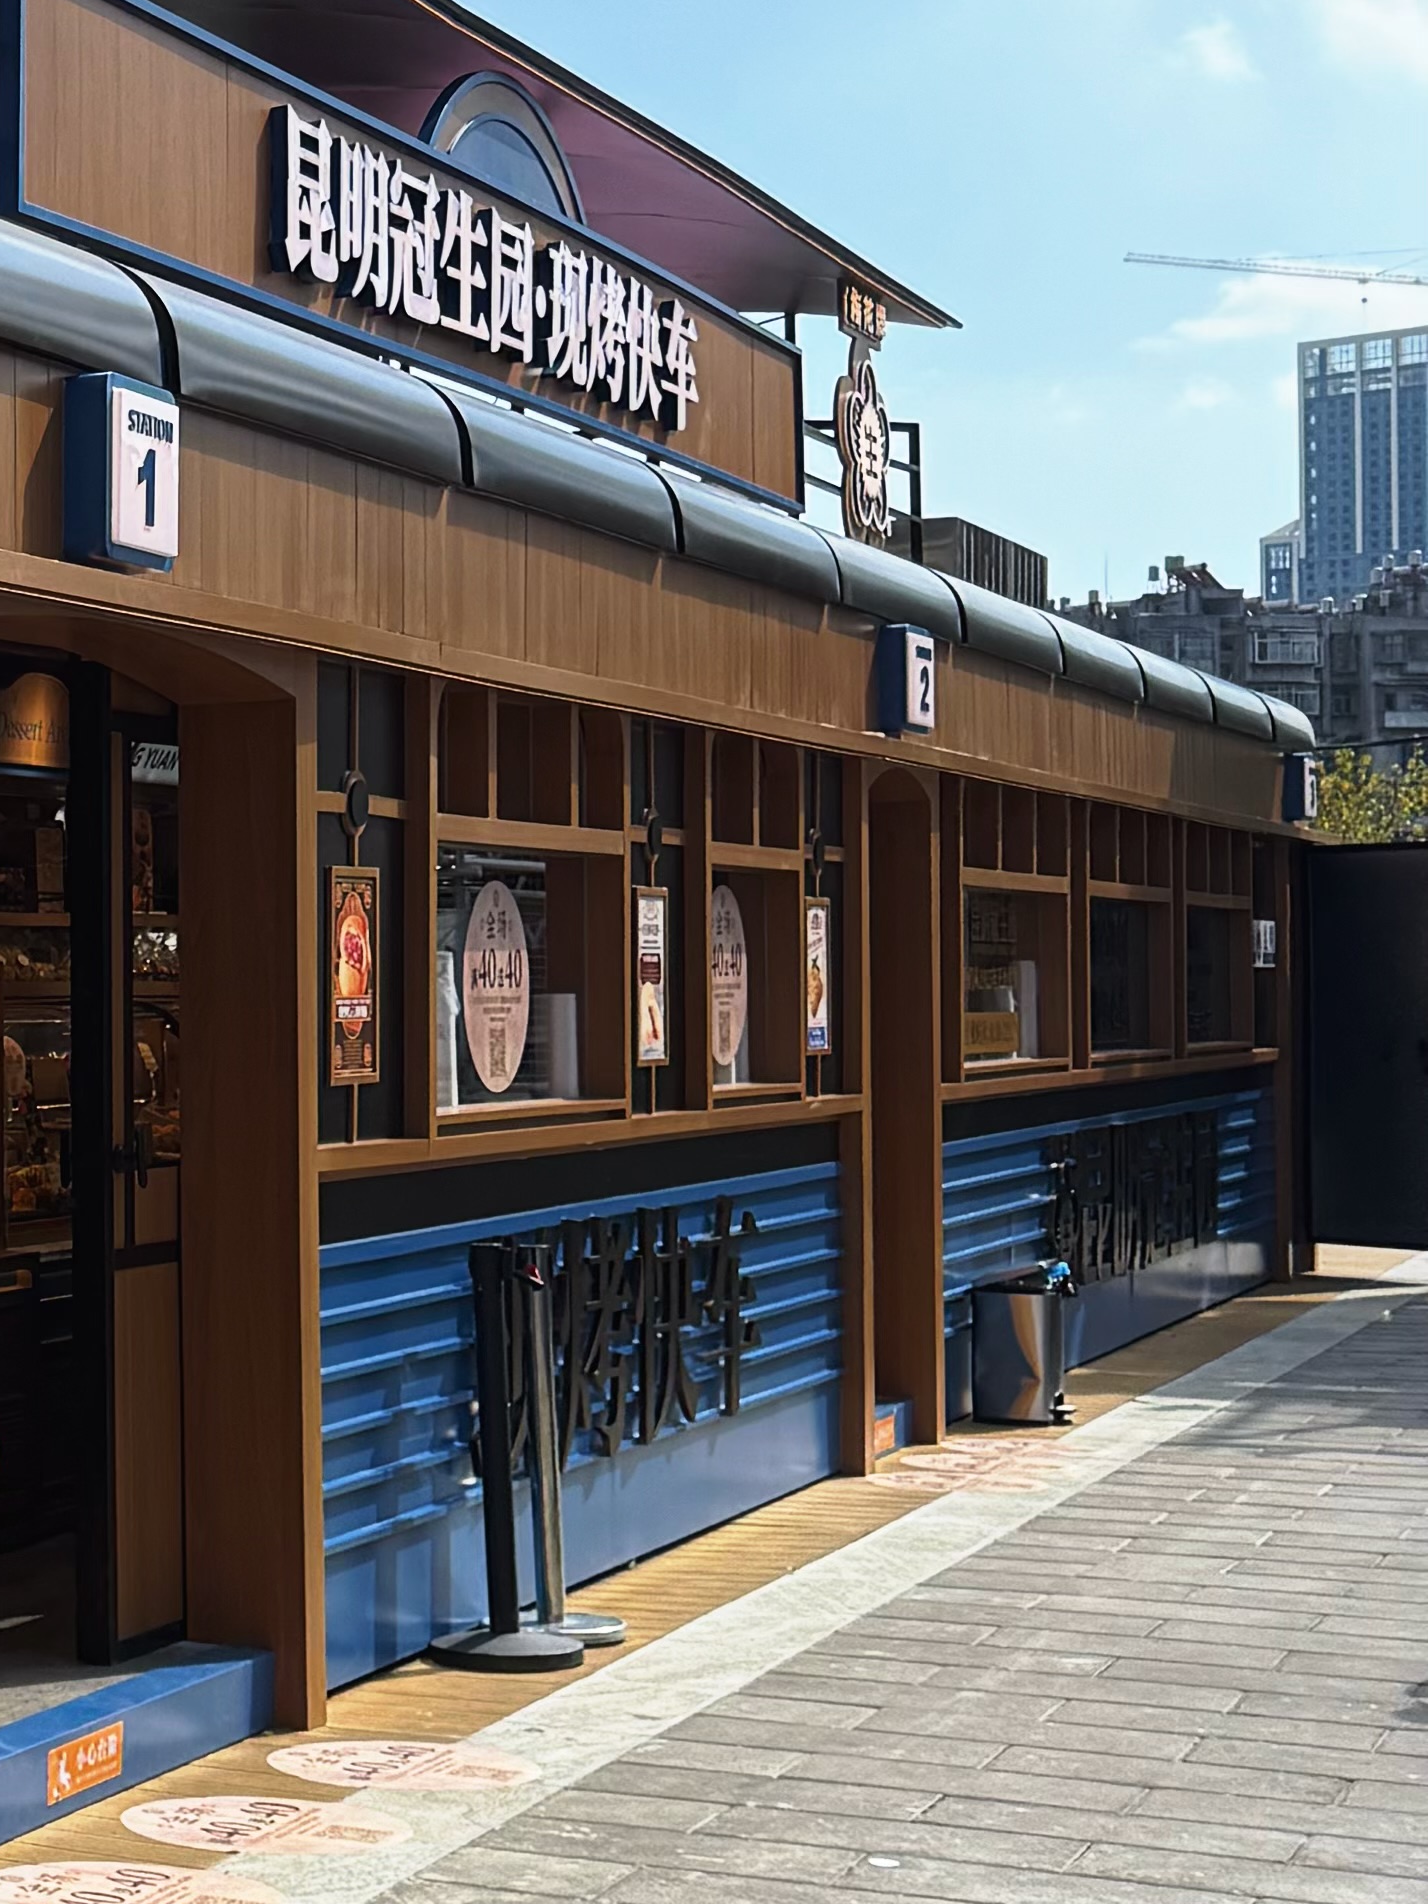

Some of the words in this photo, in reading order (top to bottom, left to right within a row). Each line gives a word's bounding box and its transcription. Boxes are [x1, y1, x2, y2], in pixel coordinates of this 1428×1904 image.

[128, 409, 174, 445] STATION
[137, 448, 156, 528] 1
[919, 665, 930, 713] 2
[144, 747, 179, 772] YUAN
